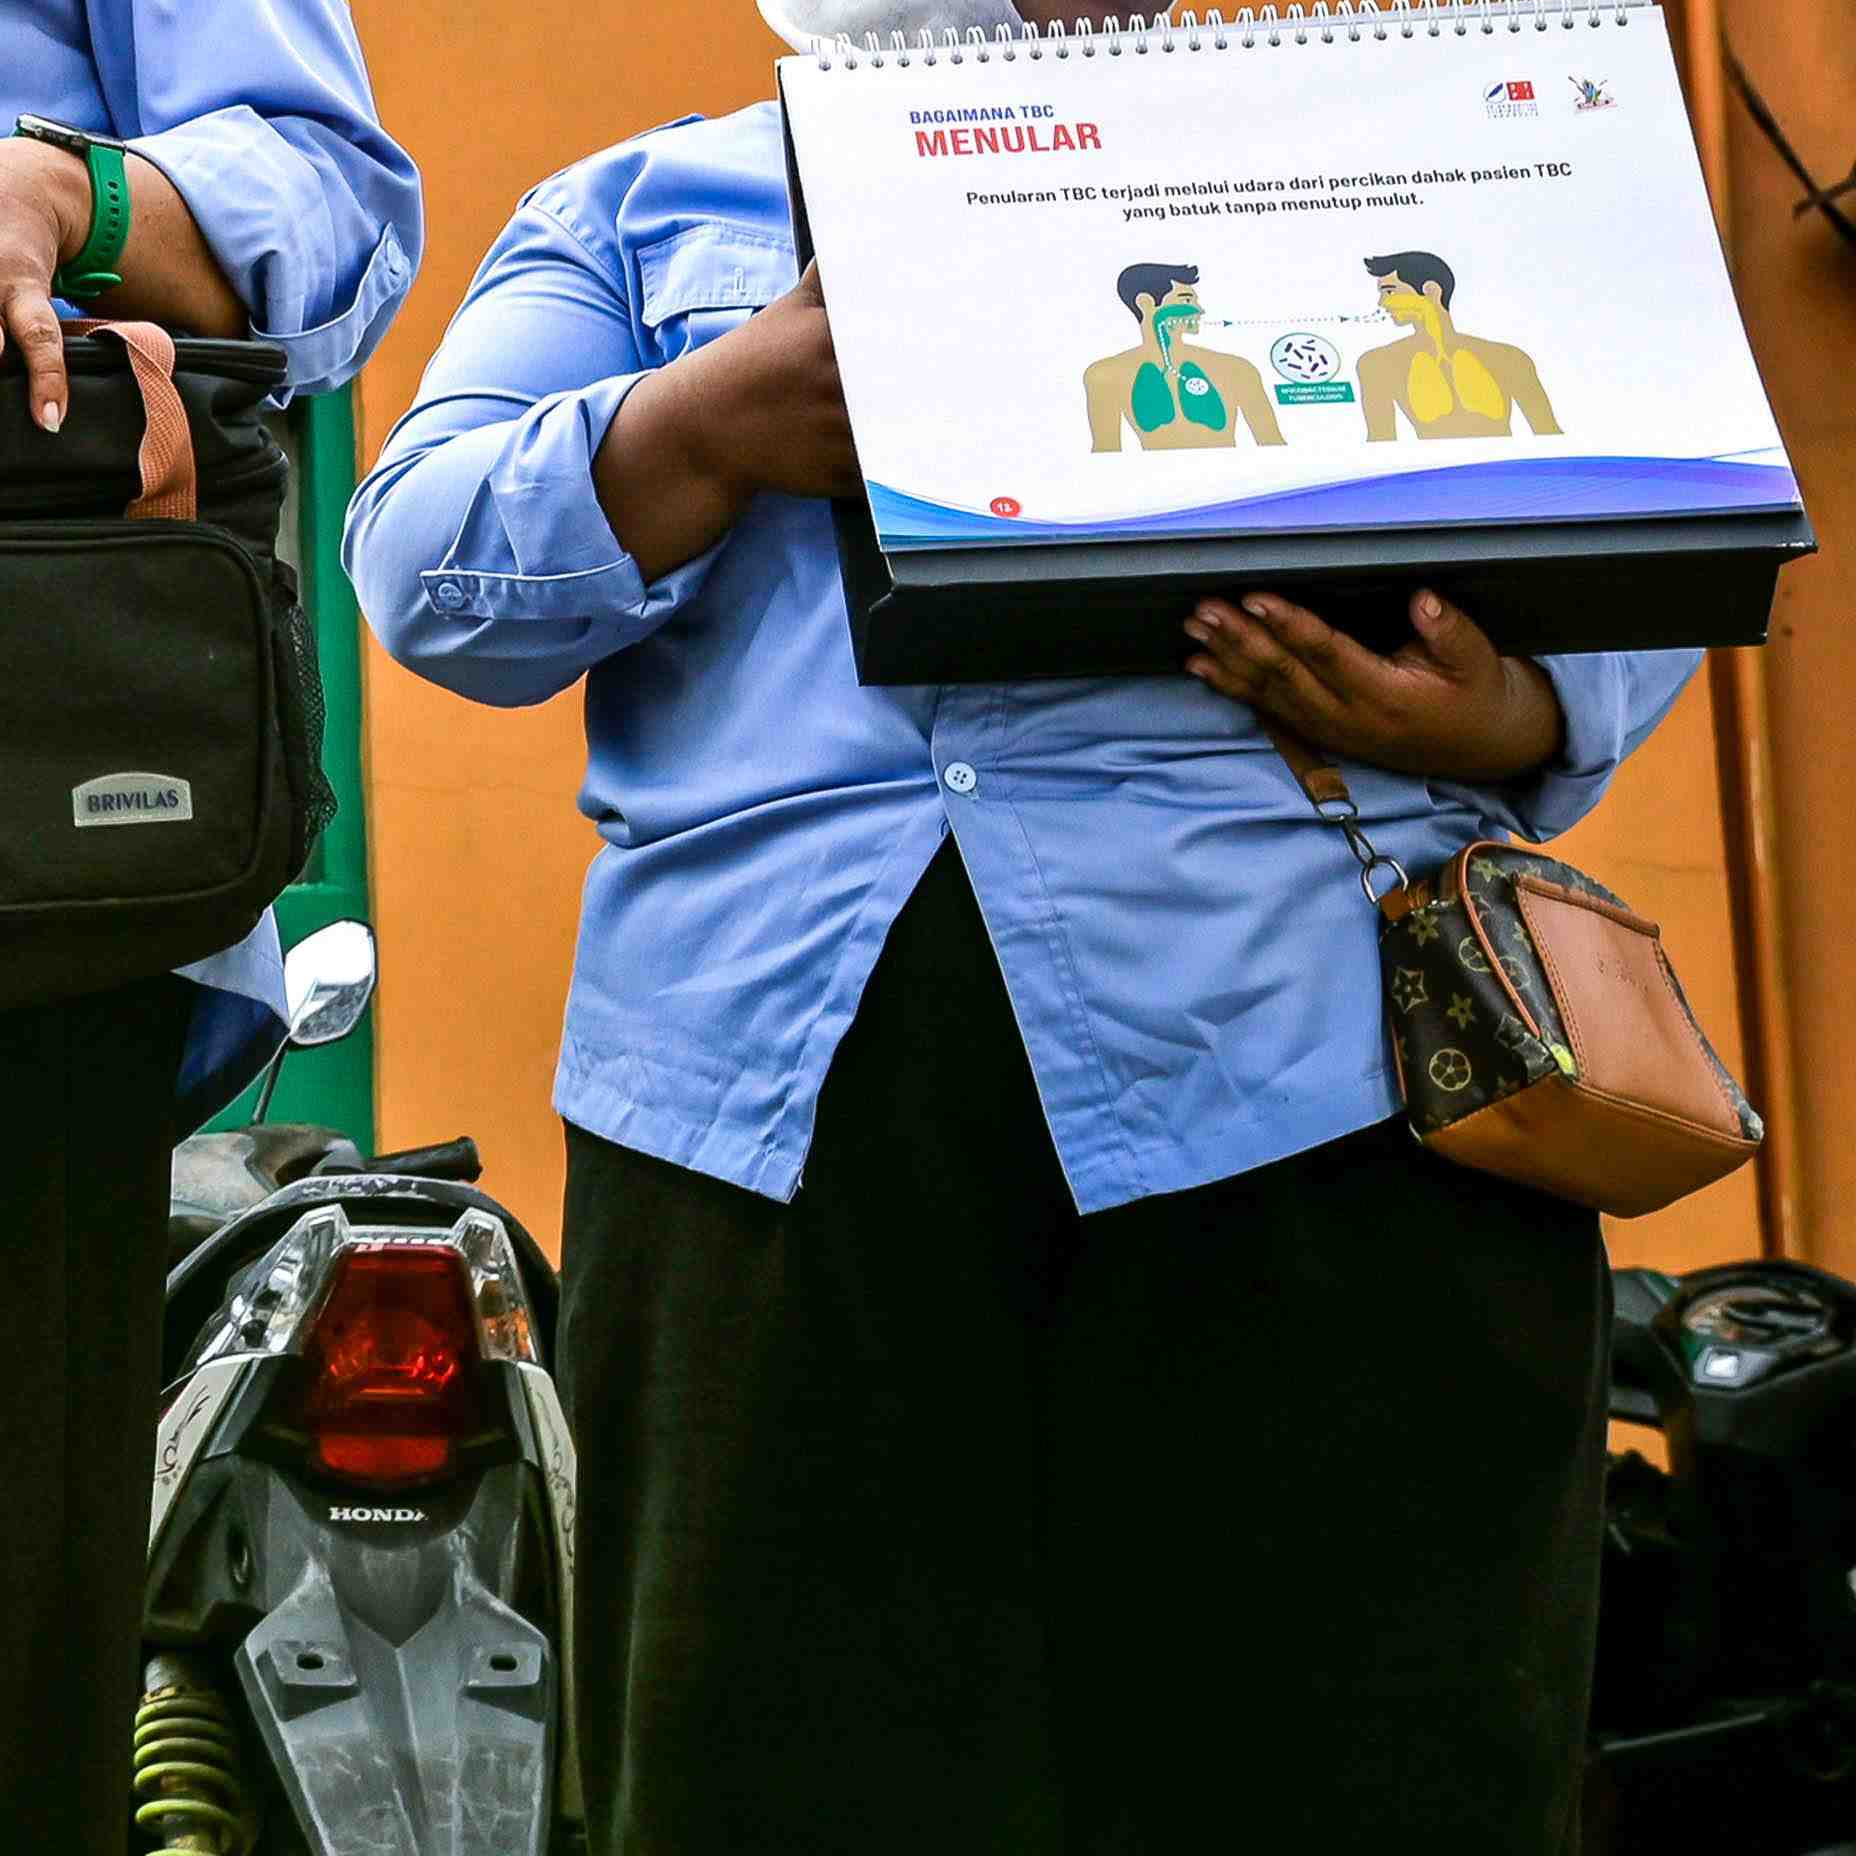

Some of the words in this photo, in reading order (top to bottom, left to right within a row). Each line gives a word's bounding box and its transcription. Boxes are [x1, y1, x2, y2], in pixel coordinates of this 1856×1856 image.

[909, 106, 1016, 125] BAGAIMANA
[1019, 104, 1055, 119] TBC
[914, 122, 1102, 157] MENULAR
[966, 189, 1057, 206] Penularan
[1060, 186, 1097, 201] TBC
[1101, 183, 1160, 202] terjadi
[1164, 180, 1230, 198] melalui
[1233, 178, 1285, 193] udara
[1289, 175, 1325, 191] dari
[1329, 171, 1407, 192] percikan
[1412, 167, 1466, 185] dahak
[1471, 164, 1531, 184] pasien
[1534, 162, 1572, 178] TBC
[1122, 205, 1166, 222] yang
[1169, 200, 1222, 217] batuk
[1225, 199, 1277, 215] tanpa
[1281, 194, 1362, 211] menutup
[1366, 192, 1424, 208] mulut.
[88, 788, 179, 813] BRIVILAS
